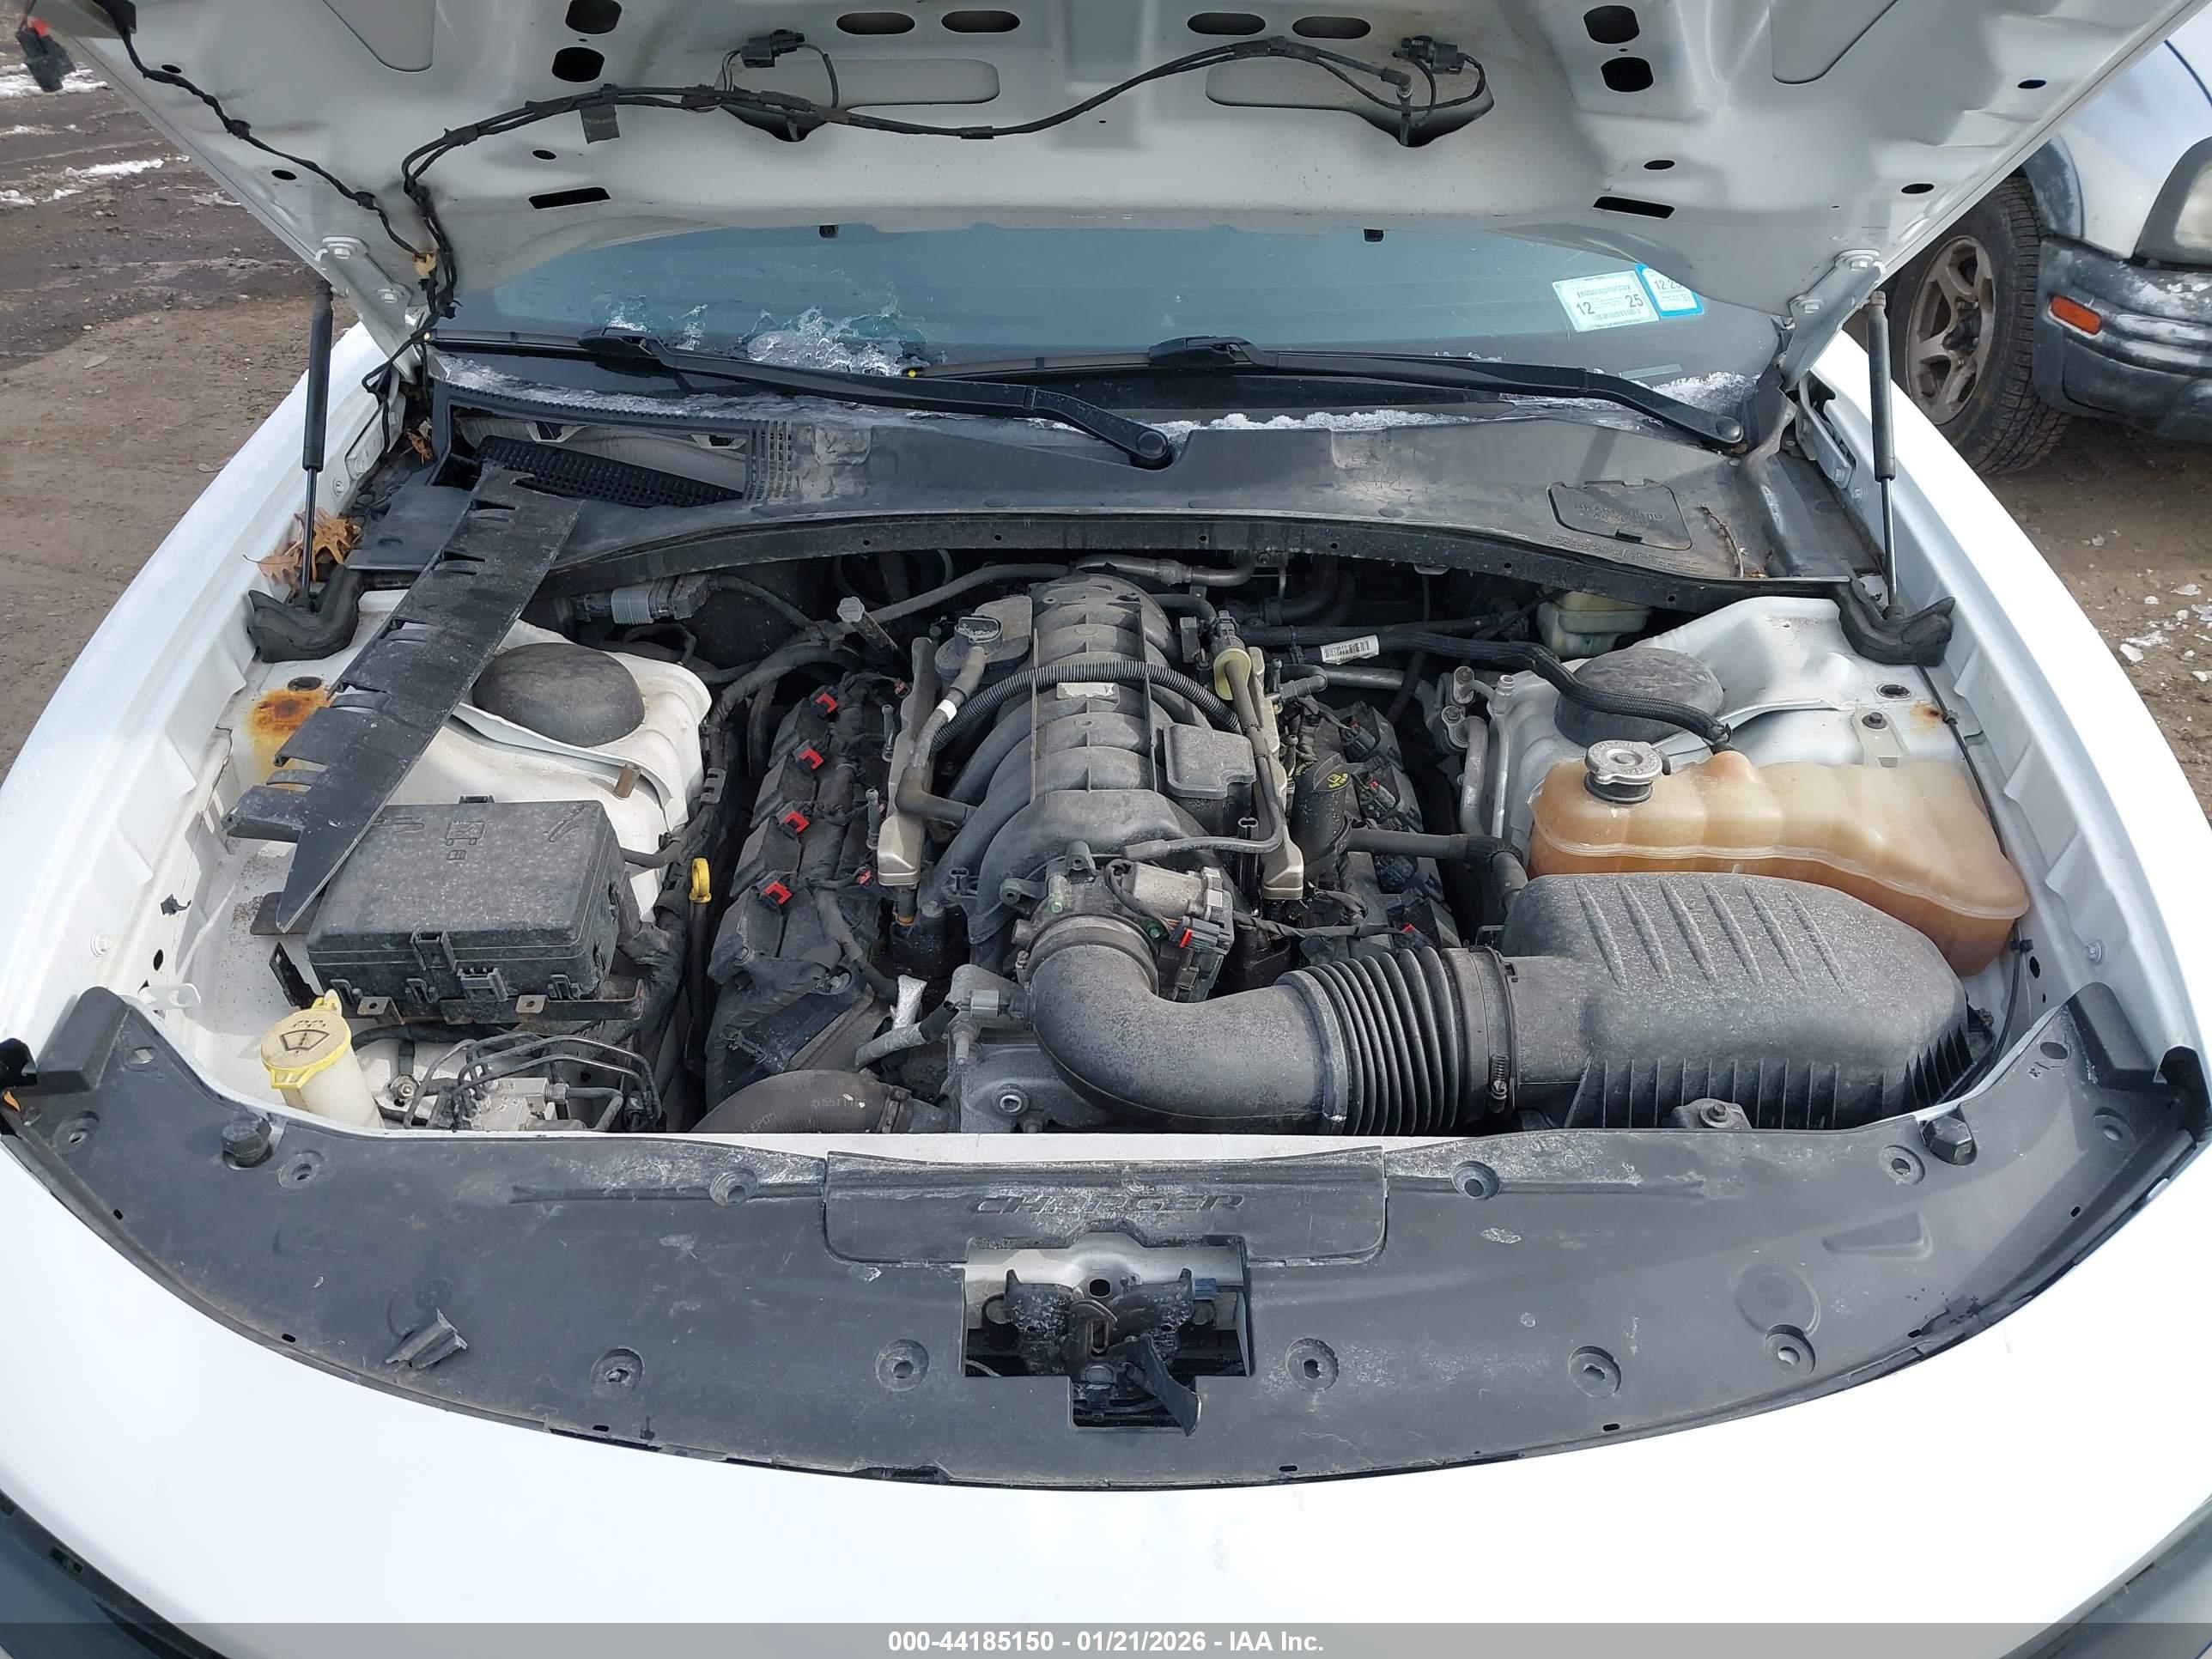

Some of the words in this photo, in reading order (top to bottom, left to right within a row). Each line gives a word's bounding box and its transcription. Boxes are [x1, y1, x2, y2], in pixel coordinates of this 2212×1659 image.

[1576, 301, 1595, 316] 12
[1624, 293, 1644, 308] 25
[973, 1194, 1245, 1213] CHARGER
